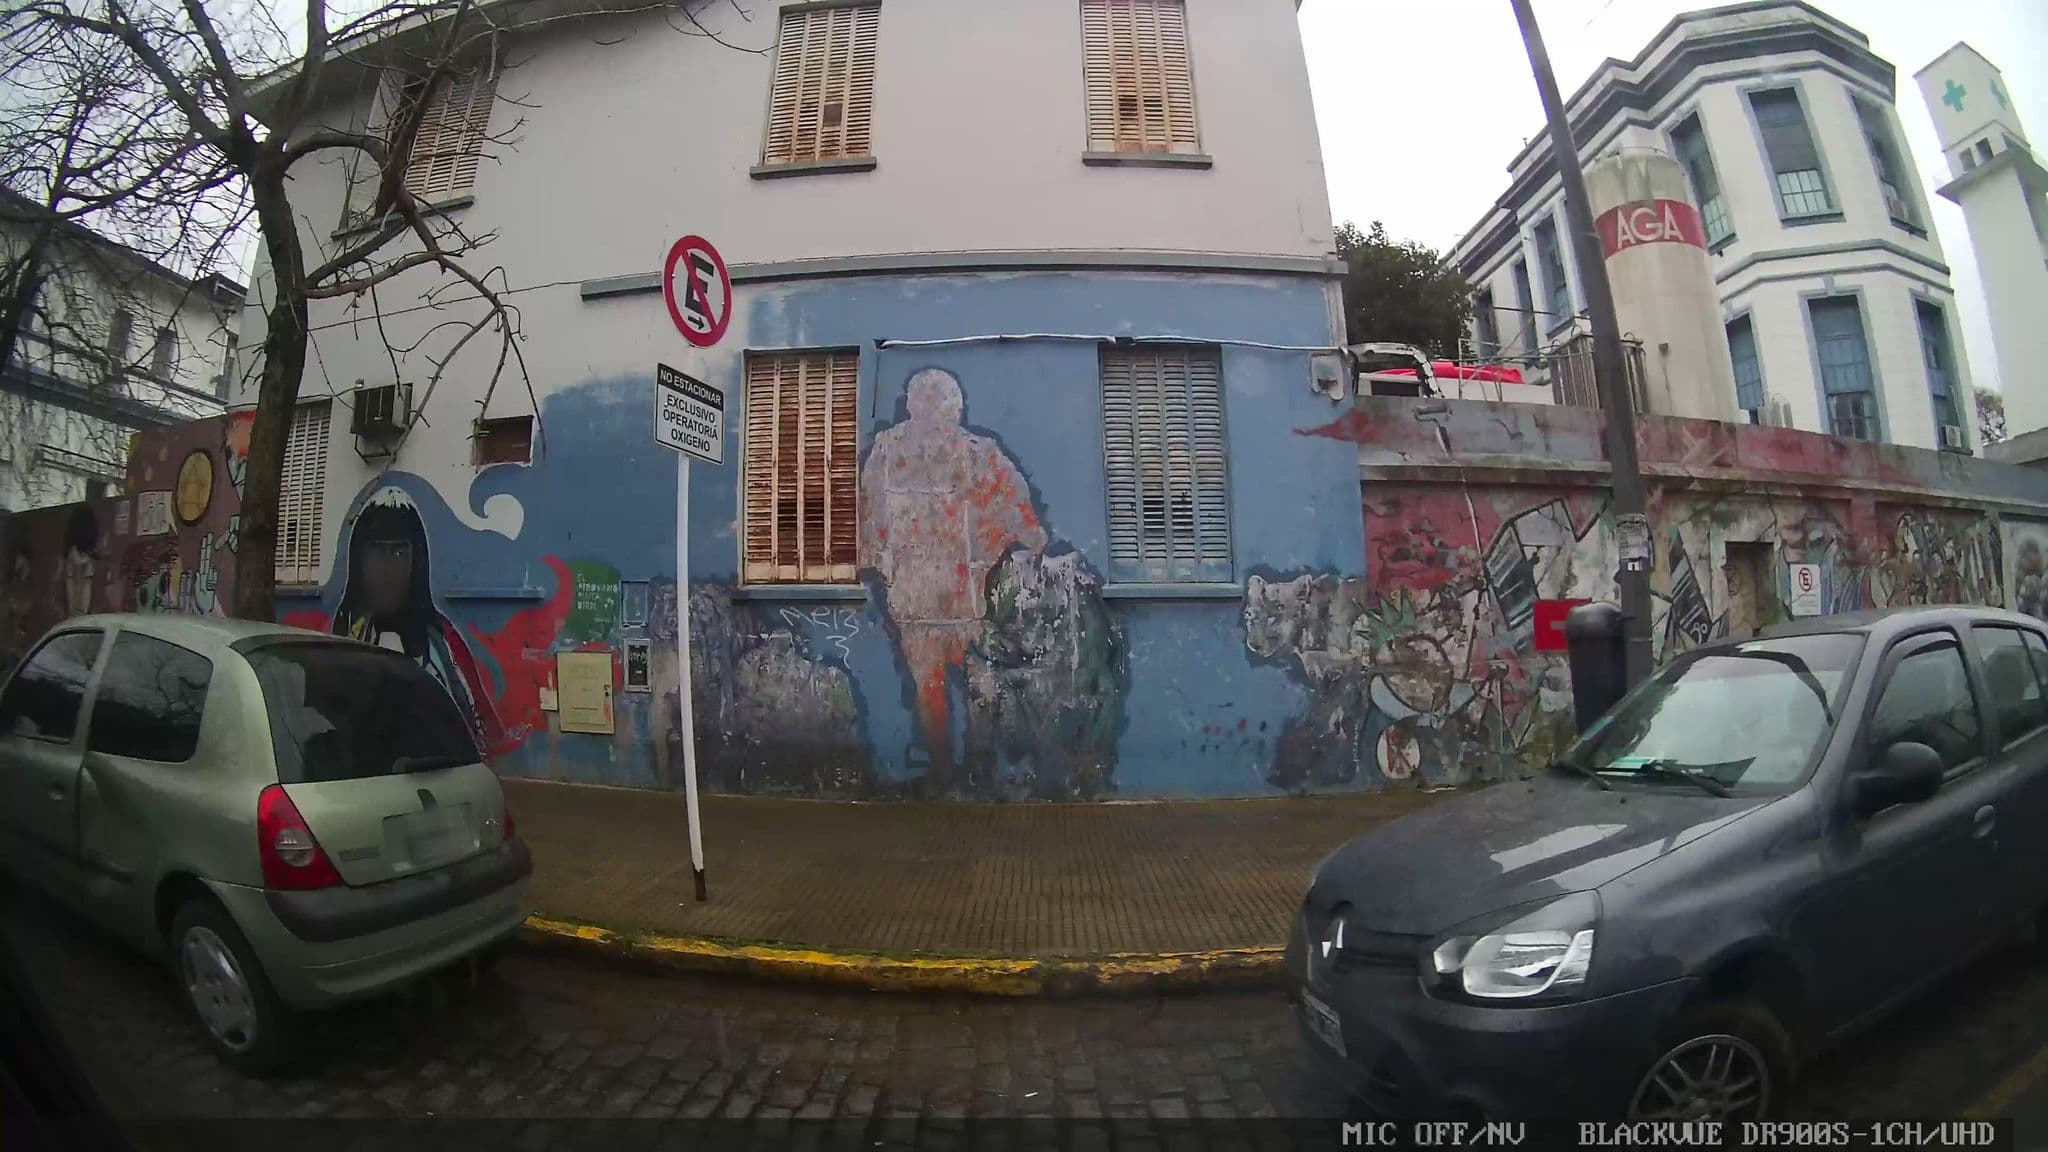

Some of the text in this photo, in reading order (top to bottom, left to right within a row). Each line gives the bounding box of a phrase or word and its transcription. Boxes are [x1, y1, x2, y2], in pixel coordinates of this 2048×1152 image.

[1617, 201, 1684, 249] AGA
[685, 252, 714, 318] E
[660, 368, 721, 404] NO ESTACIONAR
[663, 409, 718, 441] OPERATORIA
[667, 394, 715, 424] EXCLUSIVO
[671, 428, 710, 452] OXIGENO
